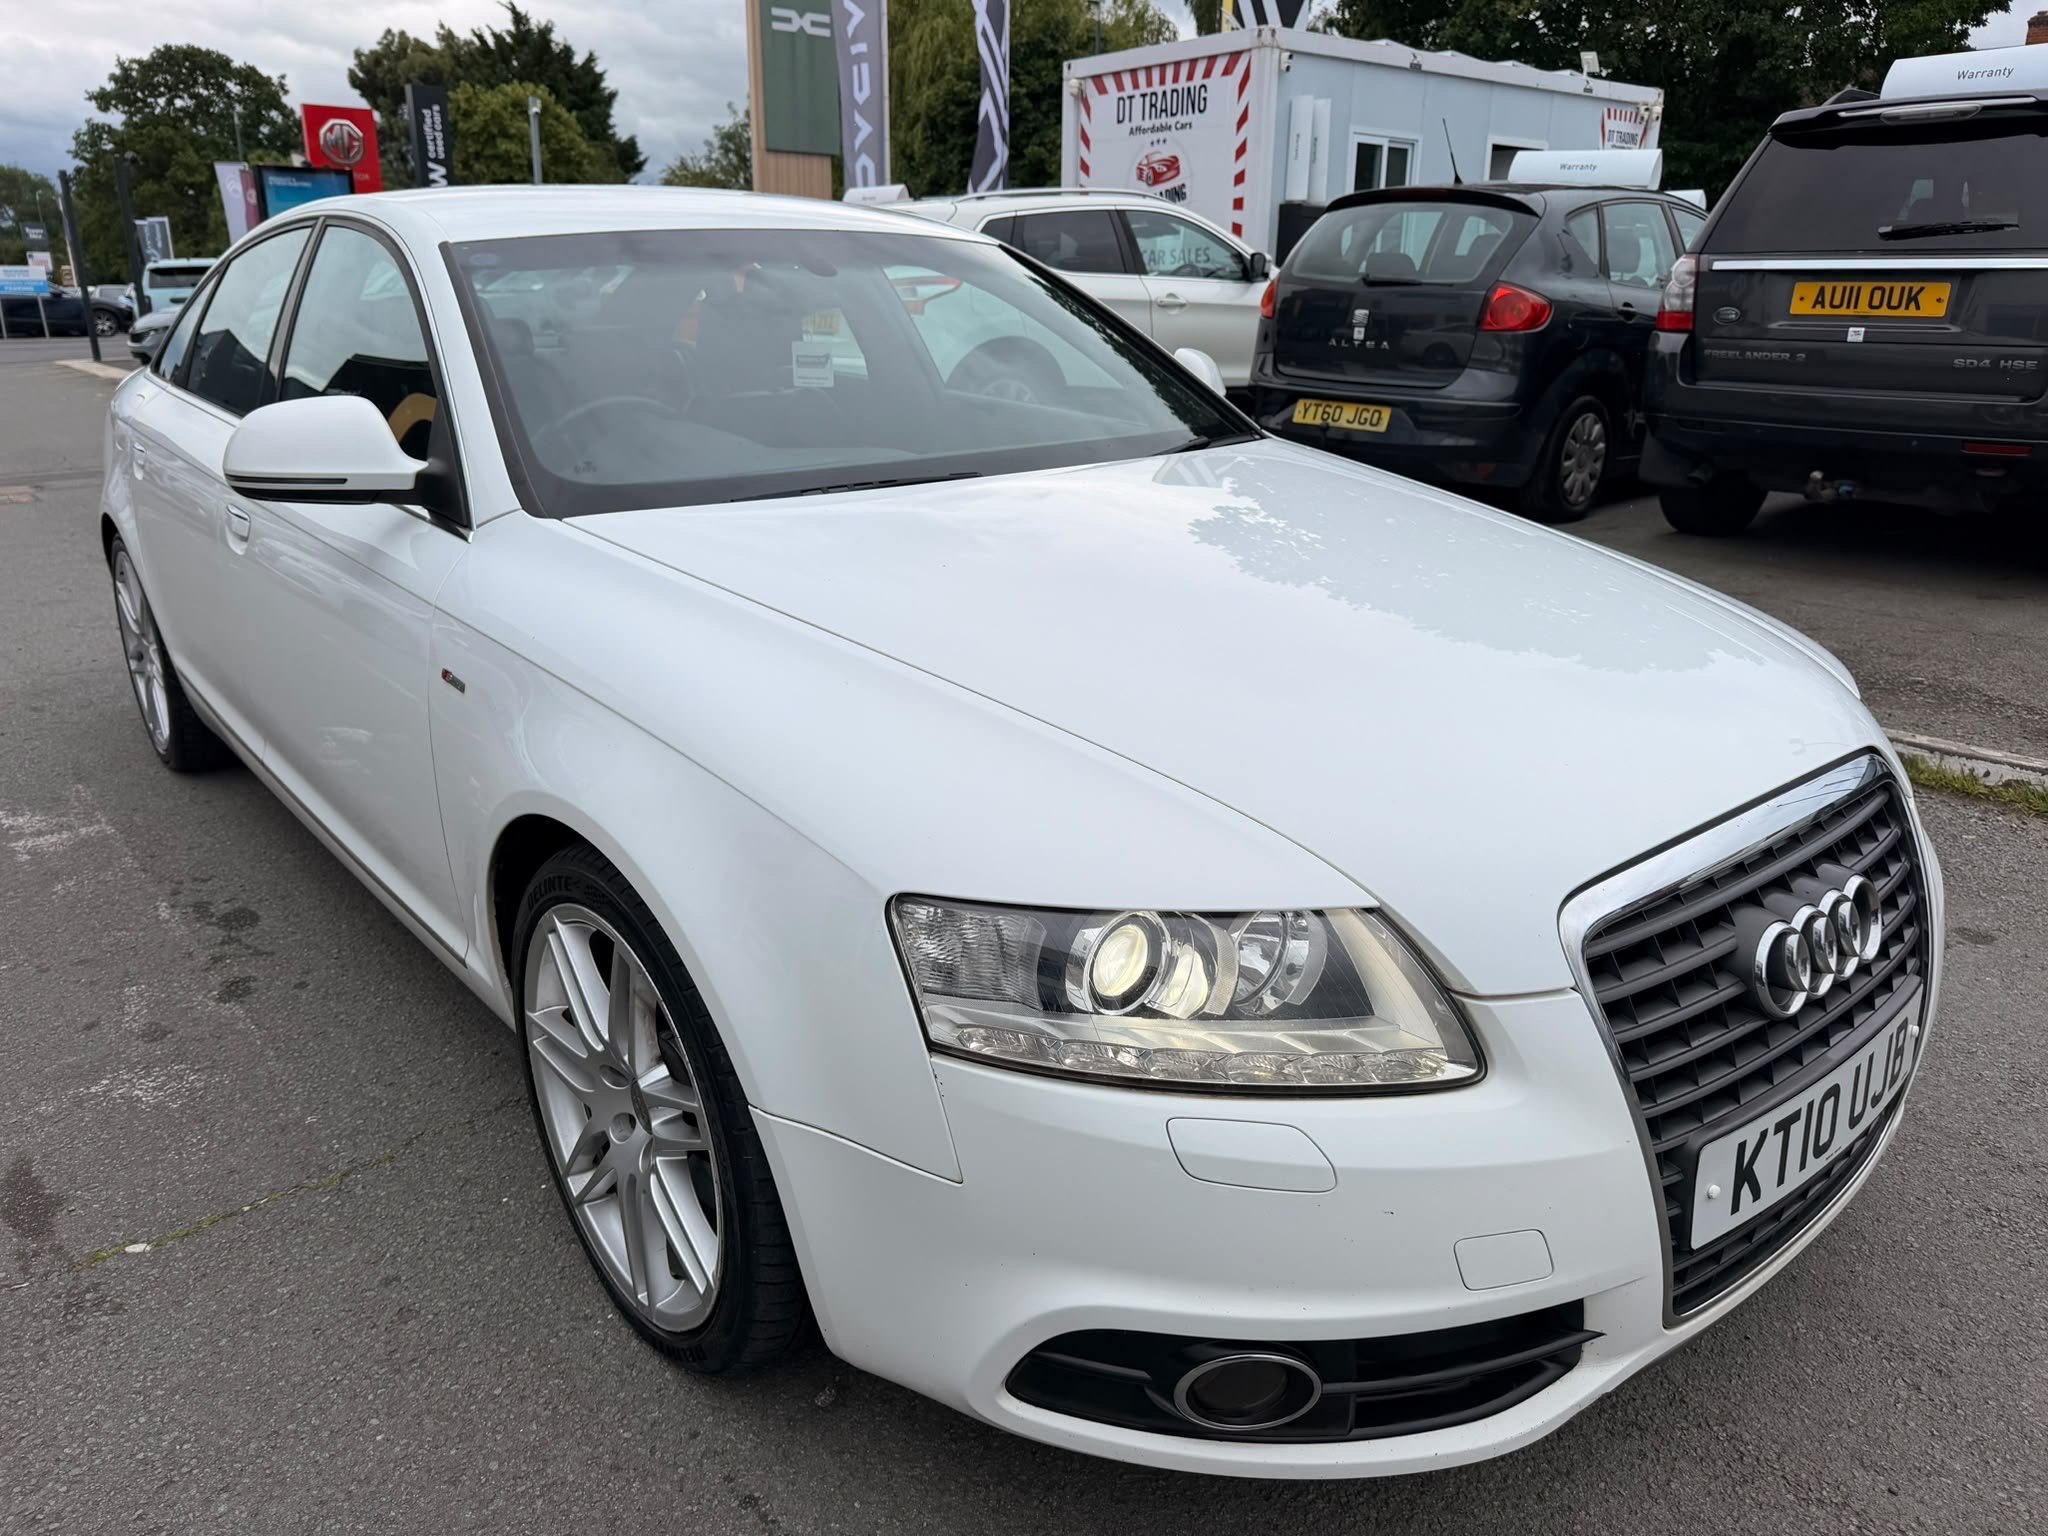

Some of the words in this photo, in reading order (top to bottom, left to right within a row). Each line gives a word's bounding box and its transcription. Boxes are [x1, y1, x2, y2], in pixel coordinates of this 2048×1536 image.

[1956, 66, 2015, 81] Warranty
[1117, 95, 1136, 124] DT
[1139, 83, 1208, 121] TRADING
[432, 104, 443, 131] cars
[1129, 122, 1172, 137] Affordable
[1174, 120, 1193, 131] Cars
[325, 123, 362, 160] MG
[421, 108, 436, 159] certified
[434, 131, 446, 159] used
[1559, 163, 1598, 172] Warranty
[1169, 246, 1211, 266] SALES
[1811, 285, 1862, 310] AU11
[1867, 286, 1926, 311] OUK
[1328, 338, 1390, 350] ALTEA
[1703, 349, 1791, 361] FREELANDER
[1796, 353, 1807, 361] 2
[1952, 358, 1992, 368] SD4
[1999, 360, 2039, 370] HSE
[1302, 402, 1344, 423] YT60
[1346, 407, 1383, 428] JGO
[1730, 1081, 1841, 1216] KT10
[1848, 1016, 1909, 1130] UJB
